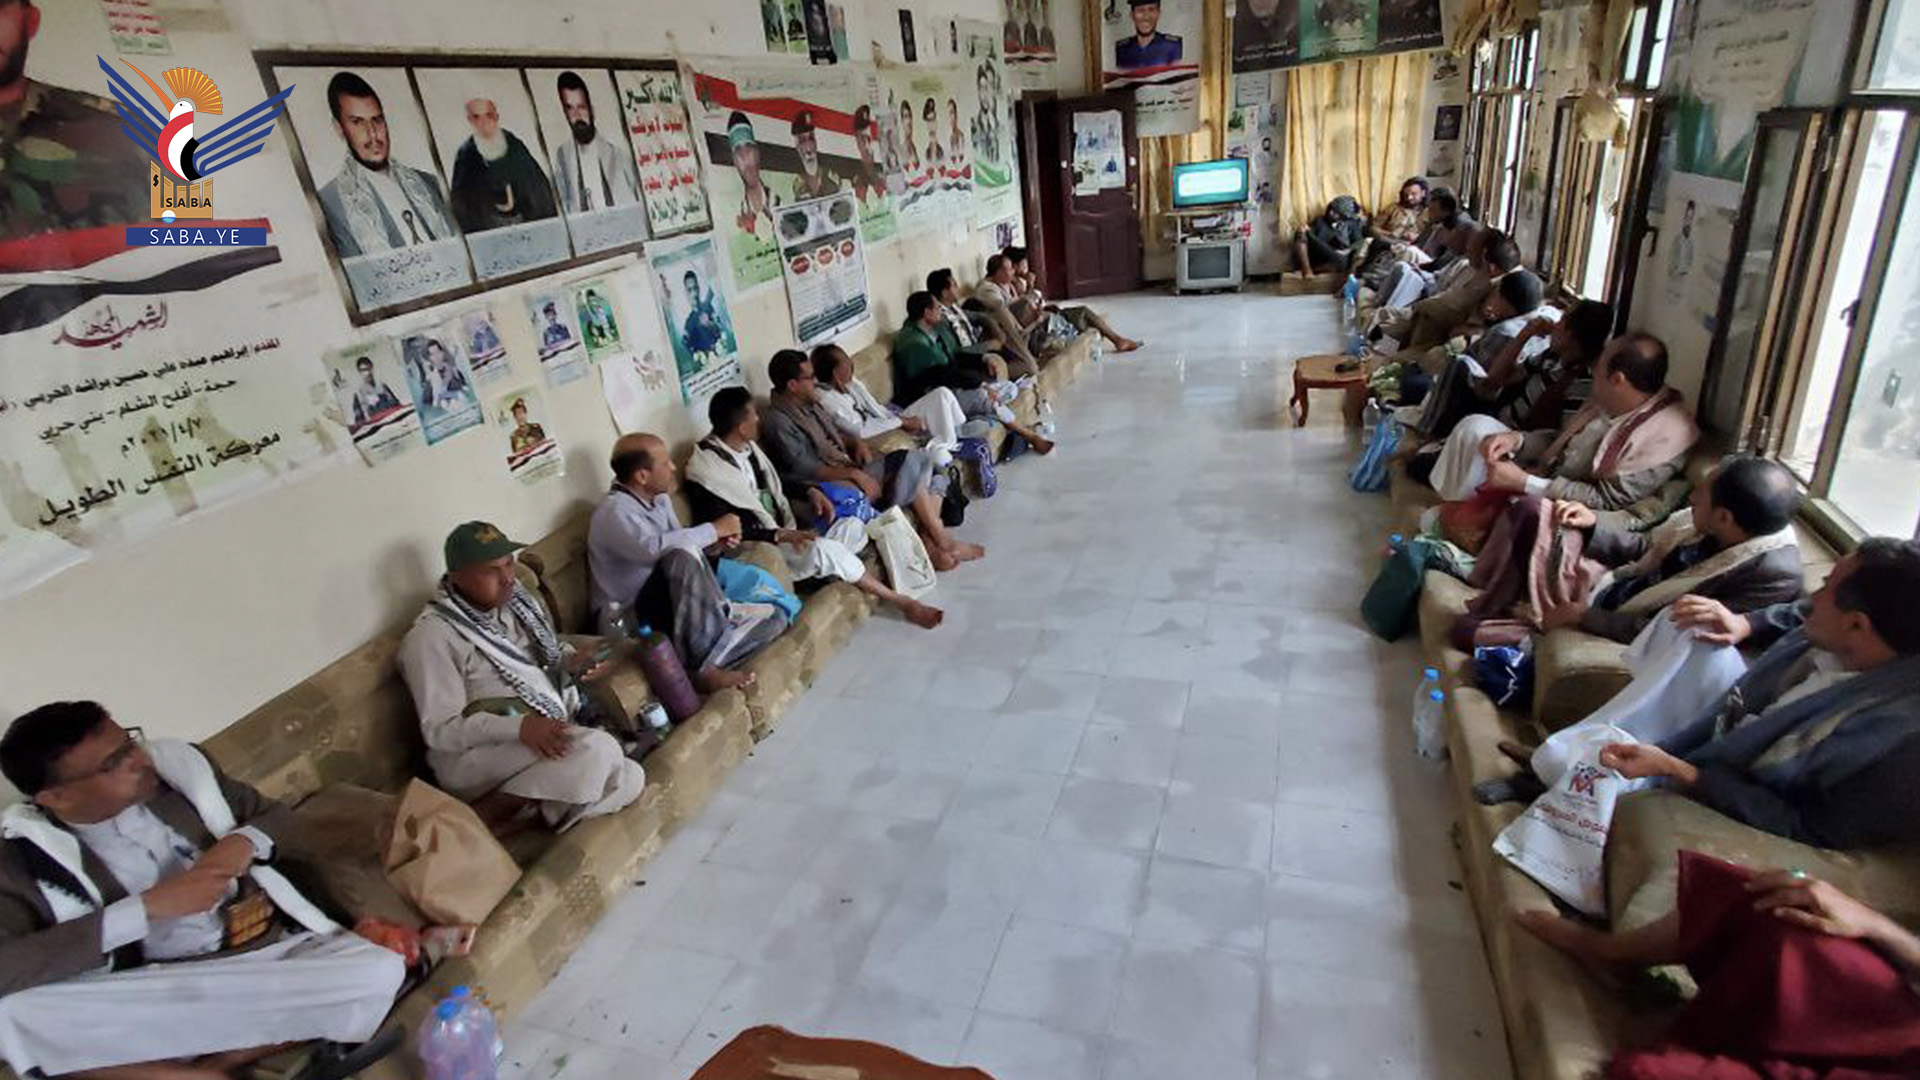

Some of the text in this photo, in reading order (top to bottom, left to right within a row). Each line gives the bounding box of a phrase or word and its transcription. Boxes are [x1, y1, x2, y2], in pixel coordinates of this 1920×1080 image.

[40, 432, 280, 526] معركة النفس الطويل
